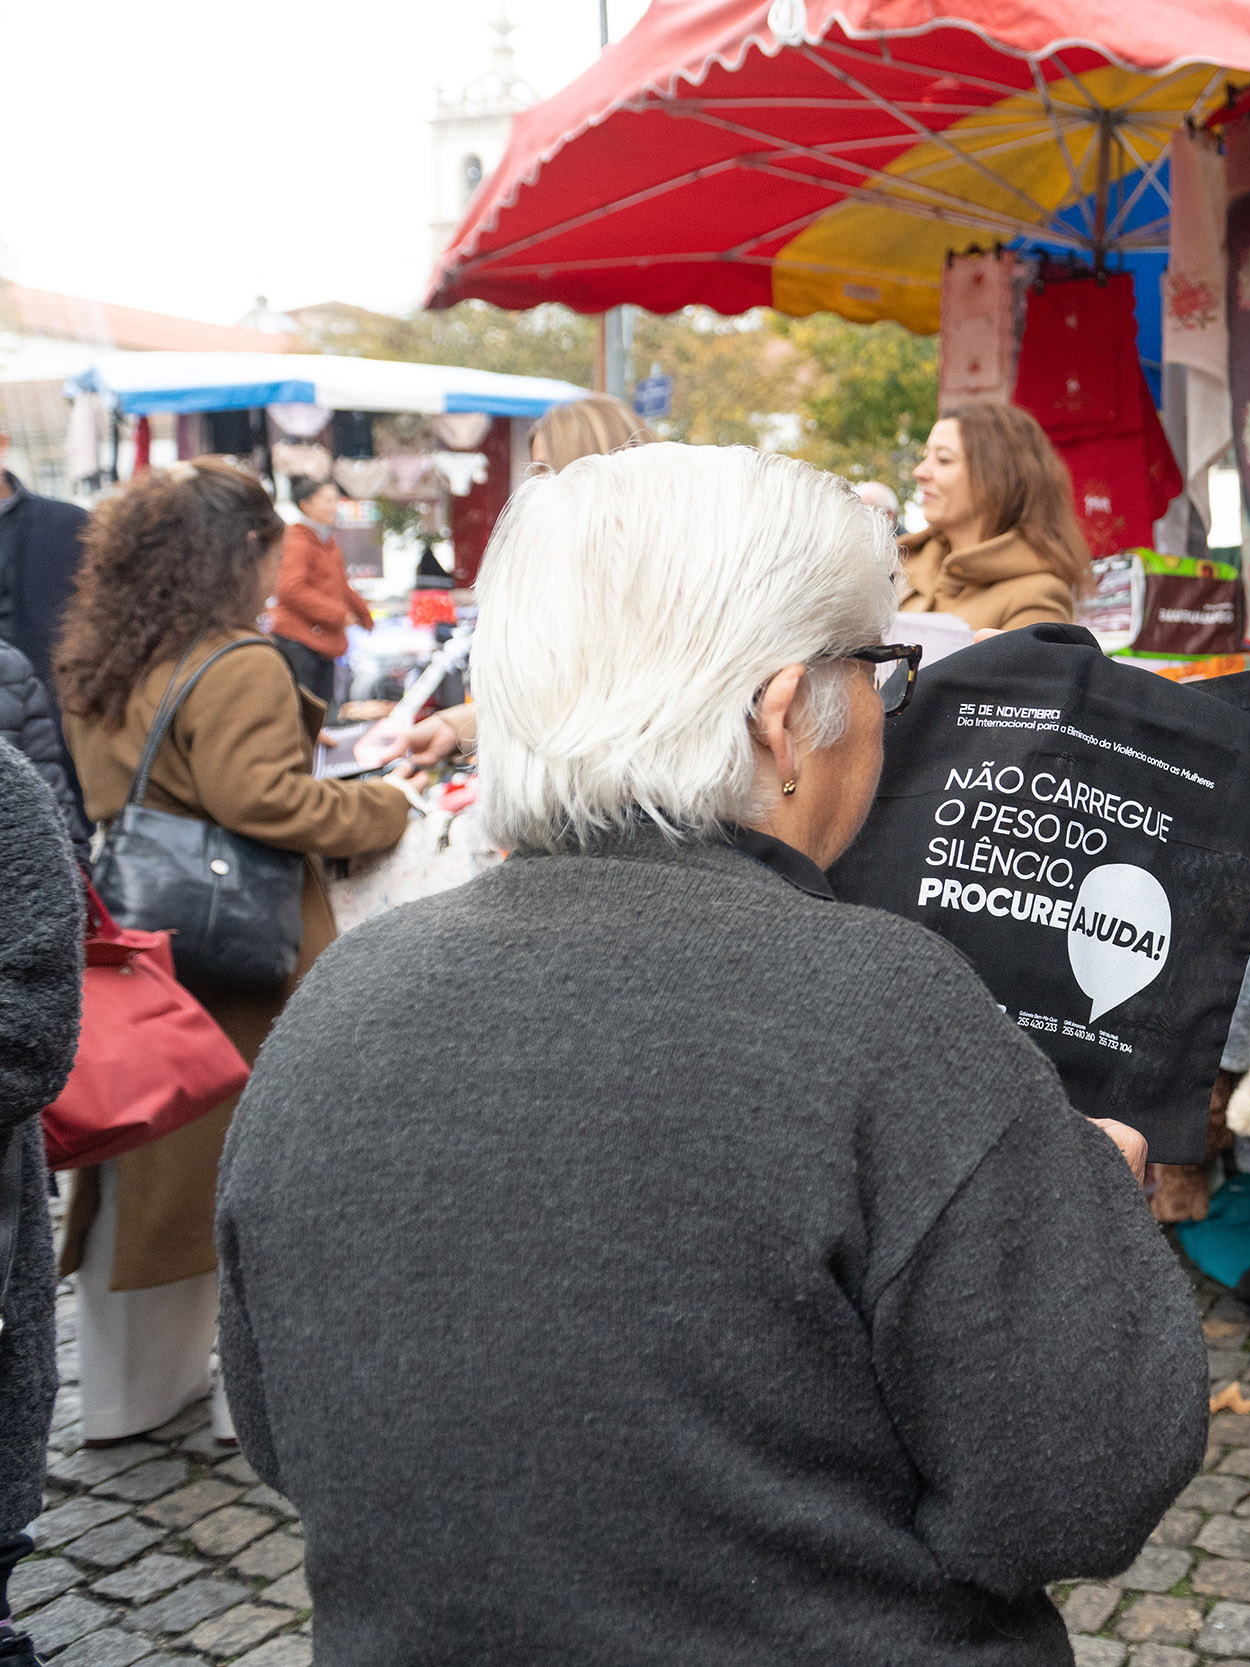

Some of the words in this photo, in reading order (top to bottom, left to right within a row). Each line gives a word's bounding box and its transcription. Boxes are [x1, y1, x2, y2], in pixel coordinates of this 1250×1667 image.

[959, 703, 975, 715] 25
[978, 704, 994, 716] DE
[997, 705, 1061, 720] NOVEMBRO
[957, 716, 974, 726] Dia
[975, 717, 1036, 729] Internacional
[1036, 719, 1060, 732] para
[1060, 725, 1067, 733] a
[1099, 738, 1112, 750] da
[1113, 741, 1147, 762] Violência
[1147, 754, 1170, 771] contra
[1169, 765, 1181, 776] as
[1180, 767, 1216, 791] Mulheres
[934, 798, 966, 827] O
[971, 801, 1062, 844] PESO
[1065, 820, 1108, 857] DO
[944, 760, 1026, 795] NÃO
[1031, 772, 1174, 844] CARREGUE
[925, 835, 1075, 890] SILÊNCIO.
[917, 877, 1074, 930] PROCURE
[1072, 905, 1167, 962] AJUDA!
[1017, 1017, 1030, 1027] 255
[1030, 1020, 1045, 1030] 420
[1044, 1022, 1058, 1033] 233
[1061, 1025, 1075, 1036] 255
[1074, 1028, 1087, 1040] 410
[1106, 1039, 1120, 1051] 732
[1119, 1042, 1133, 1054] 104
